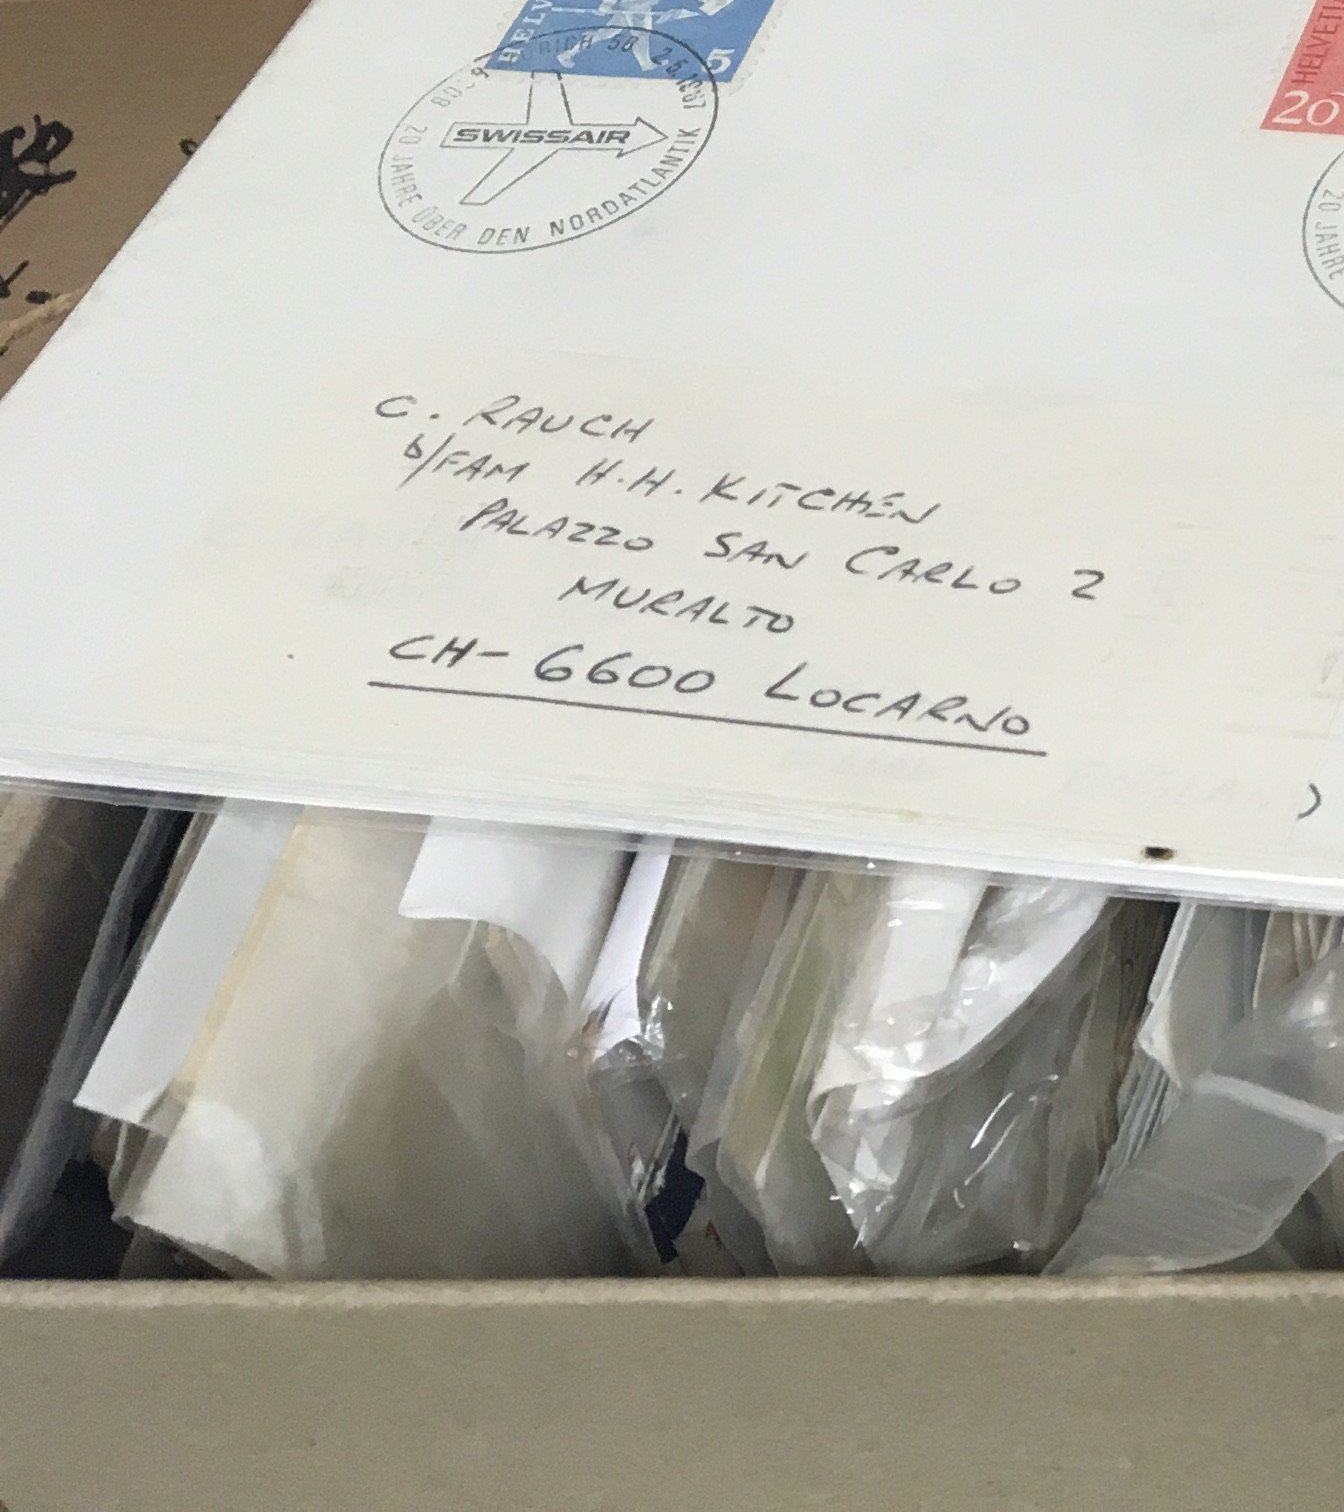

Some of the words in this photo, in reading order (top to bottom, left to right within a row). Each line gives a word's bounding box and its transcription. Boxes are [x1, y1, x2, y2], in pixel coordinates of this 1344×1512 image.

[706, 49, 735, 74] 5
[1271, 89, 1339, 127] 20
[399, 125, 428, 146] 20
[453, 127, 631, 145] SWISSAIR
[390, 154, 423, 208] JAHRE
[549, 127, 701, 238] NORDATLANTIK
[411, 204, 468, 242] ÜBER
[476, 225, 531, 247] DEN
[462, 394, 654, 443] RAUCH
[460, 498, 654, 553] PALAZZO
[703, 531, 810, 572] SAN
[845, 546, 1022, 596] CARLO
[1071, 569, 1106, 600] 2
[558, 576, 795, 634] MURALTO
[764, 661, 1030, 738] LOCARNO
